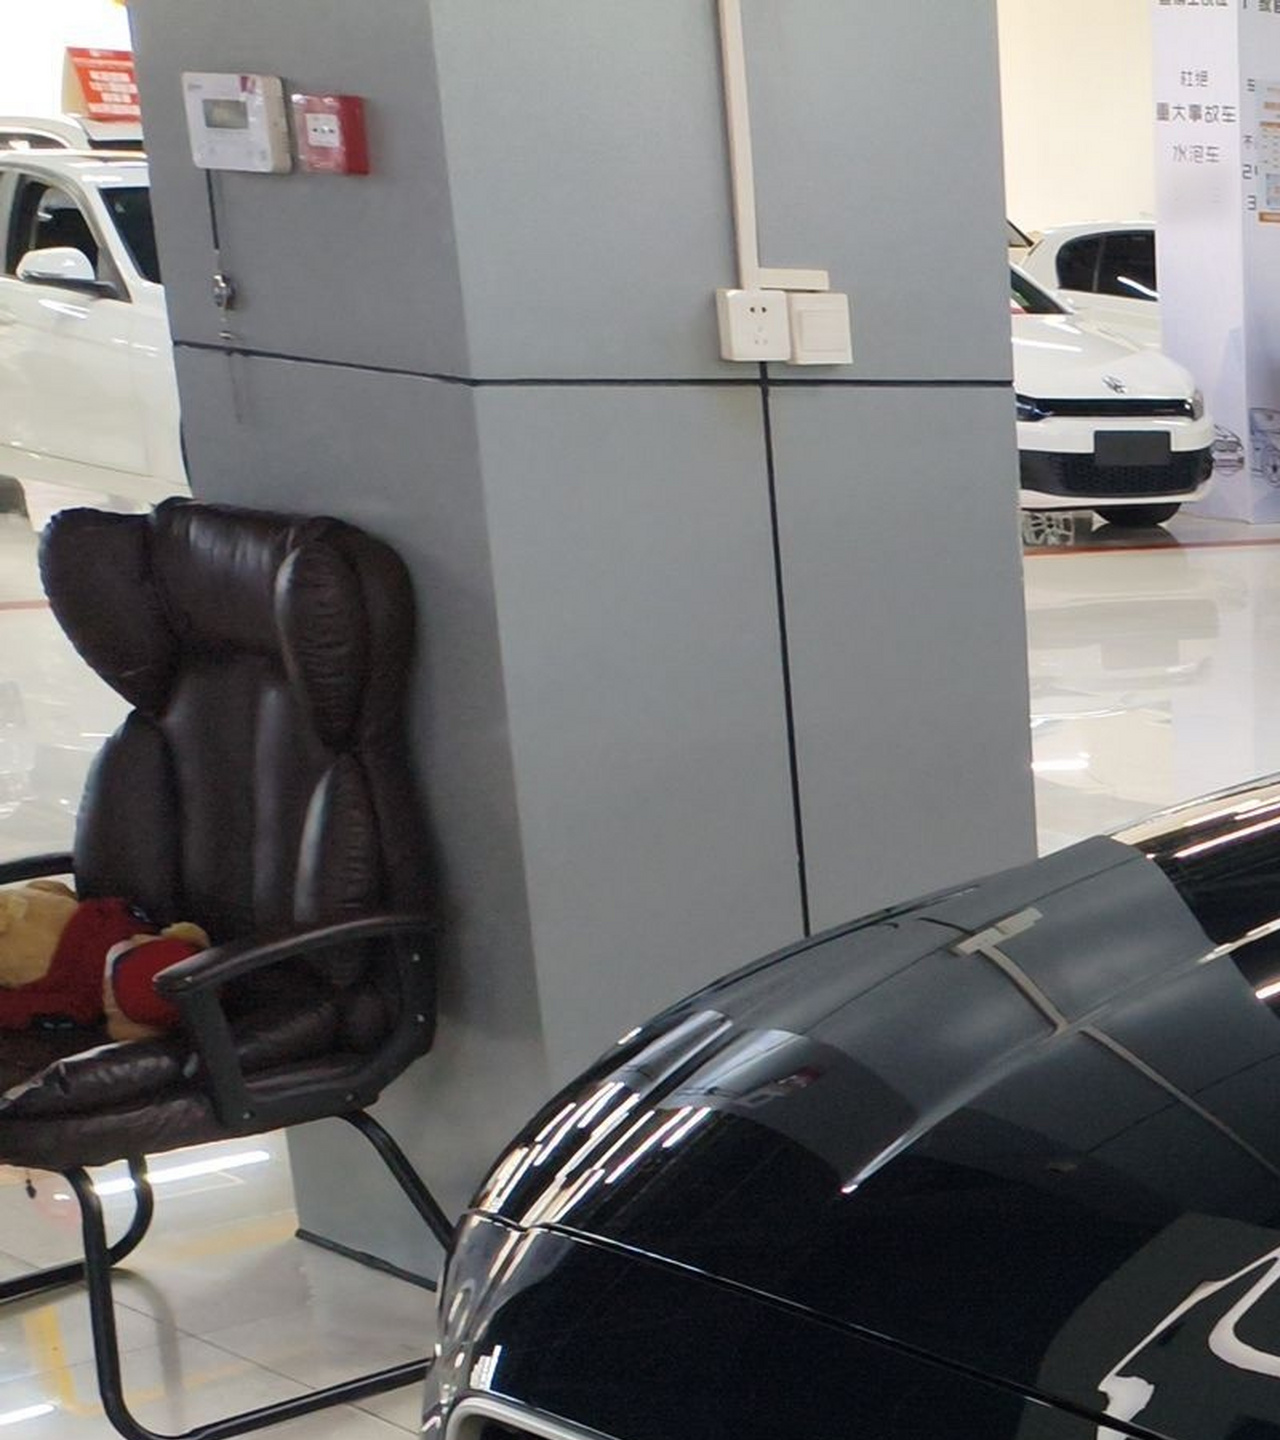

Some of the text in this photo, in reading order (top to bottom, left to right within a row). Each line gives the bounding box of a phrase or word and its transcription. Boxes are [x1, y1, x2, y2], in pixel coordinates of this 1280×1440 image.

[1156, 102, 1236, 123] 重大事故车
[1173, 145, 1219, 164] 水泡车
